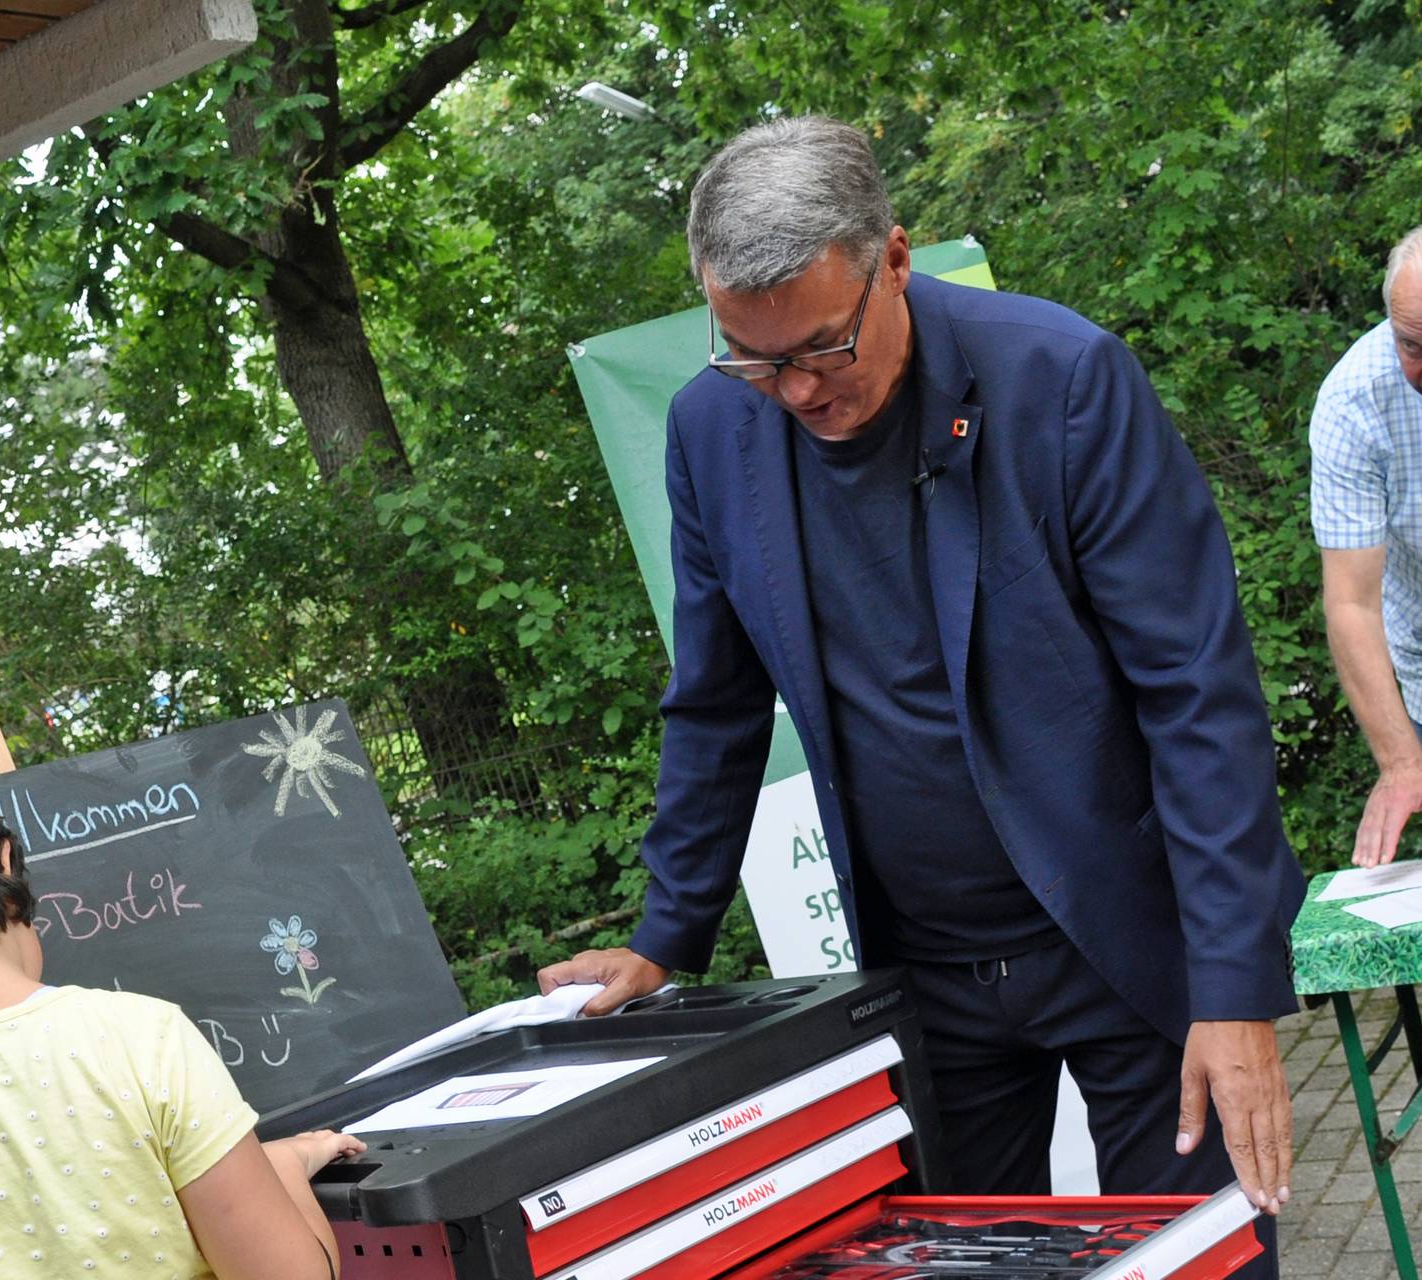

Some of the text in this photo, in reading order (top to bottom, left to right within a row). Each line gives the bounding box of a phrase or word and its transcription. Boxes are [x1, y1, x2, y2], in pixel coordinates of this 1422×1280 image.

[38, 868, 203, 940] Batik
[688, 1104, 763, 1147] HOLZMANN
[703, 1180, 776, 1226] HOLZMANN
